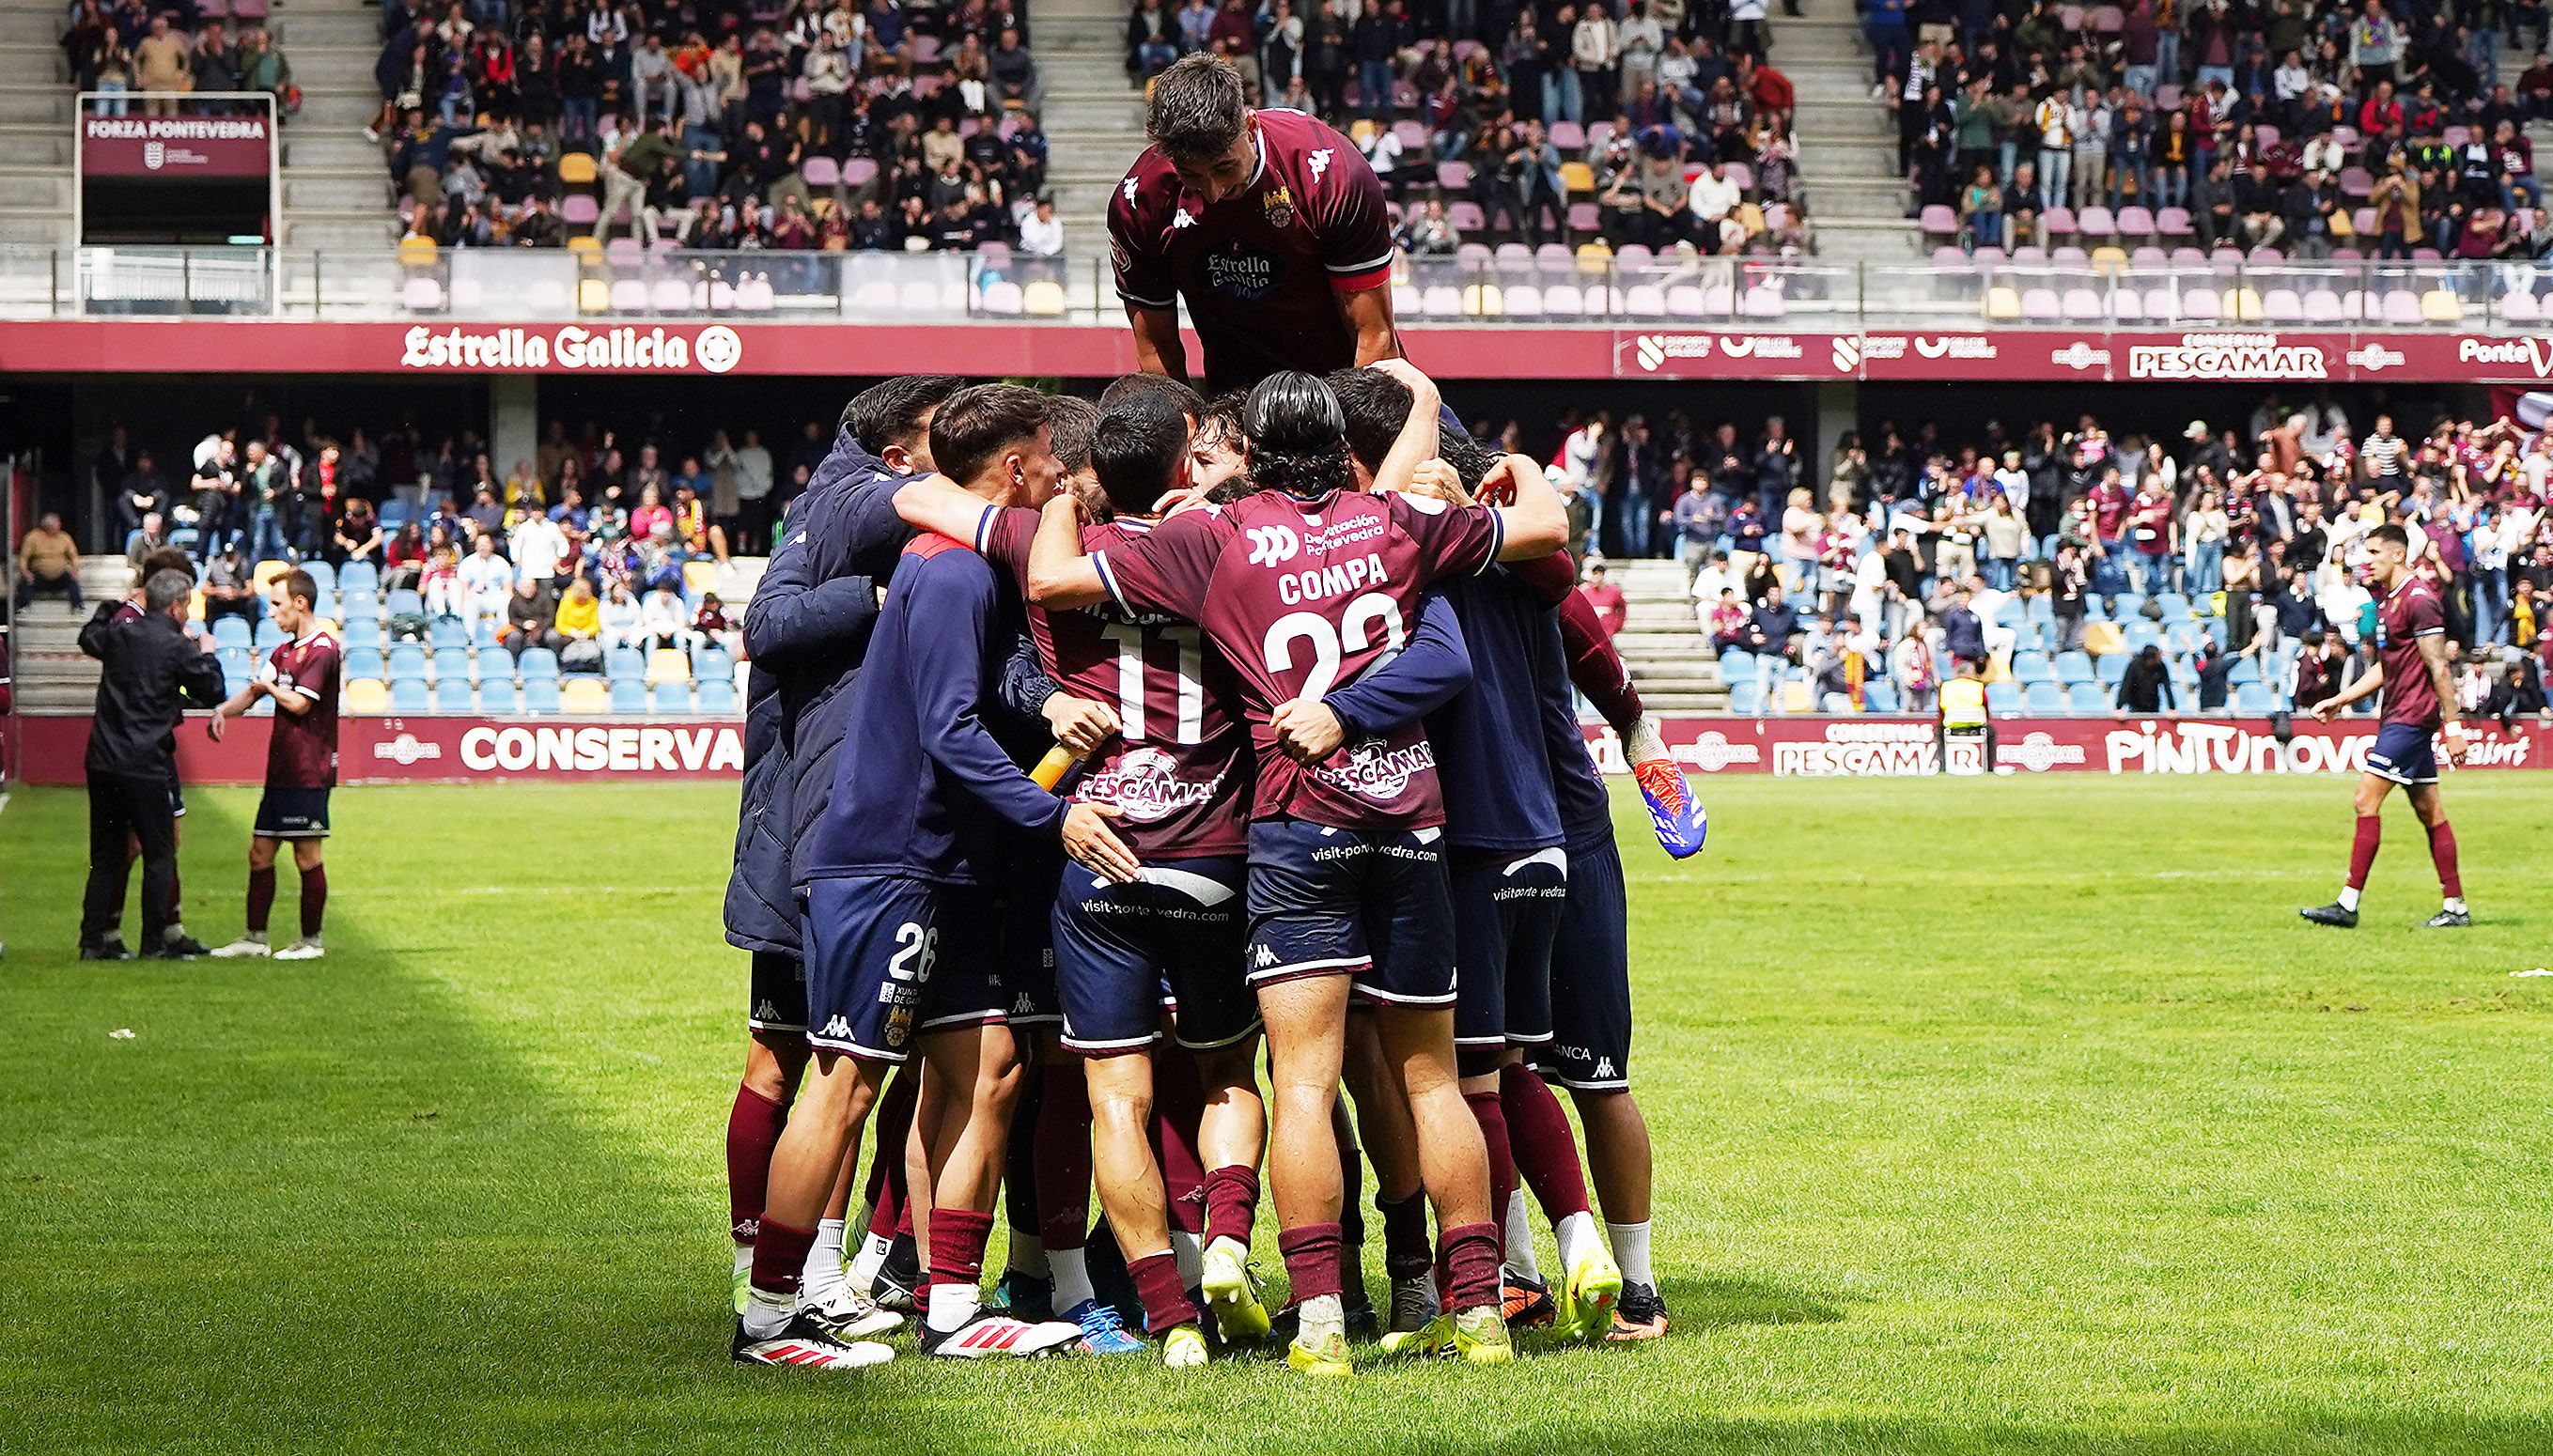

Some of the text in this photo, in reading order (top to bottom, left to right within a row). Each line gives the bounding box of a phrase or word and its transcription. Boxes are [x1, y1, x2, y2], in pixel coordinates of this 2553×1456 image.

[87, 120, 264, 139] FORZA PONTEVEDRA
[1207, 255, 1270, 272] Estrella
[400, 325, 691, 368] Estrella Galicia
[2130, 347, 2328, 378] PESCAMAR
[1306, 525, 1385, 556] Pontevedra
[1278, 552, 1389, 606] COMPA
[1100, 623, 1203, 745] 11
[889, 922, 938, 984] 26
[1553, 1043, 1593, 1061] ANCA
